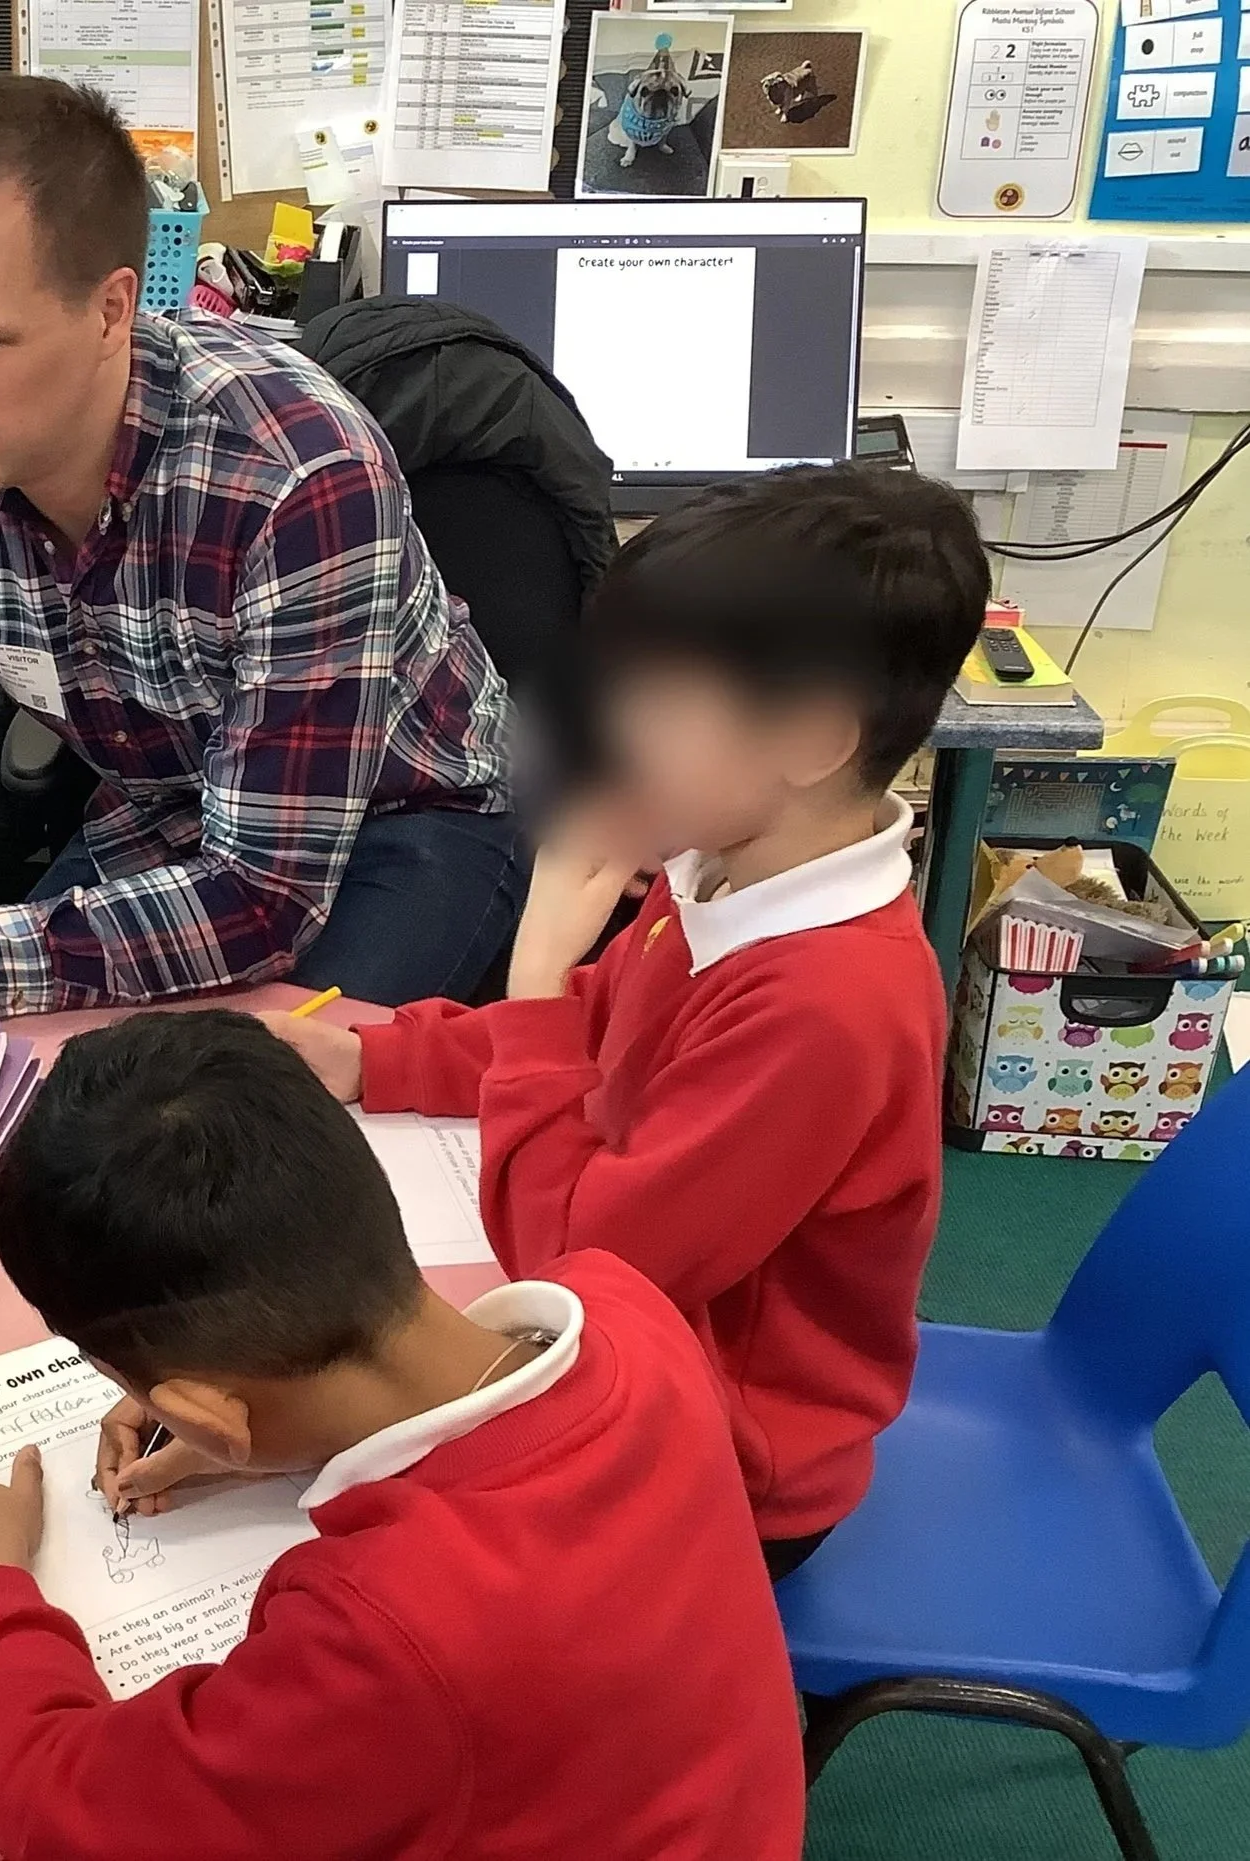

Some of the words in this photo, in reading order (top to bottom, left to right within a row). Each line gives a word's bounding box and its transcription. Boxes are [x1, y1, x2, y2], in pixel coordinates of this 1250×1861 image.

[1036, 8, 1054, 17] Infant
[1006, 44, 1016, 58] 2
[578, 257, 615, 268] Create
[618, 258, 644, 271] your
[648, 259, 671, 267] own
[7, 654, 39, 665] VISITOR
[1217, 808, 1229, 823] of
[1161, 826, 1183, 841] the
[6, 1369, 45, 1389] own
[22, 1377, 80, 1403] character's
[98, 1630, 120, 1644] Are
[122, 1616, 151, 1634] they
[152, 1609, 169, 1620] an
[171, 1587, 216, 1613] animal?
[220, 1582, 231, 1593] A
[109, 1644, 132, 1658] Are
[134, 1630, 163, 1648] they
[163, 1621, 184, 1635] big
[186, 1615, 198, 1625] or
[202, 1597, 238, 1618] small?
[120, 1659, 139, 1672] Do
[141, 1645, 170, 1663] they
[171, 1634, 200, 1650] wear
[216, 1614, 241, 1630] hat?
[132, 1672, 151, 1685] Do
[182, 1647, 206, 1664] fly?
[210, 1630, 246, 1652] Jump?
